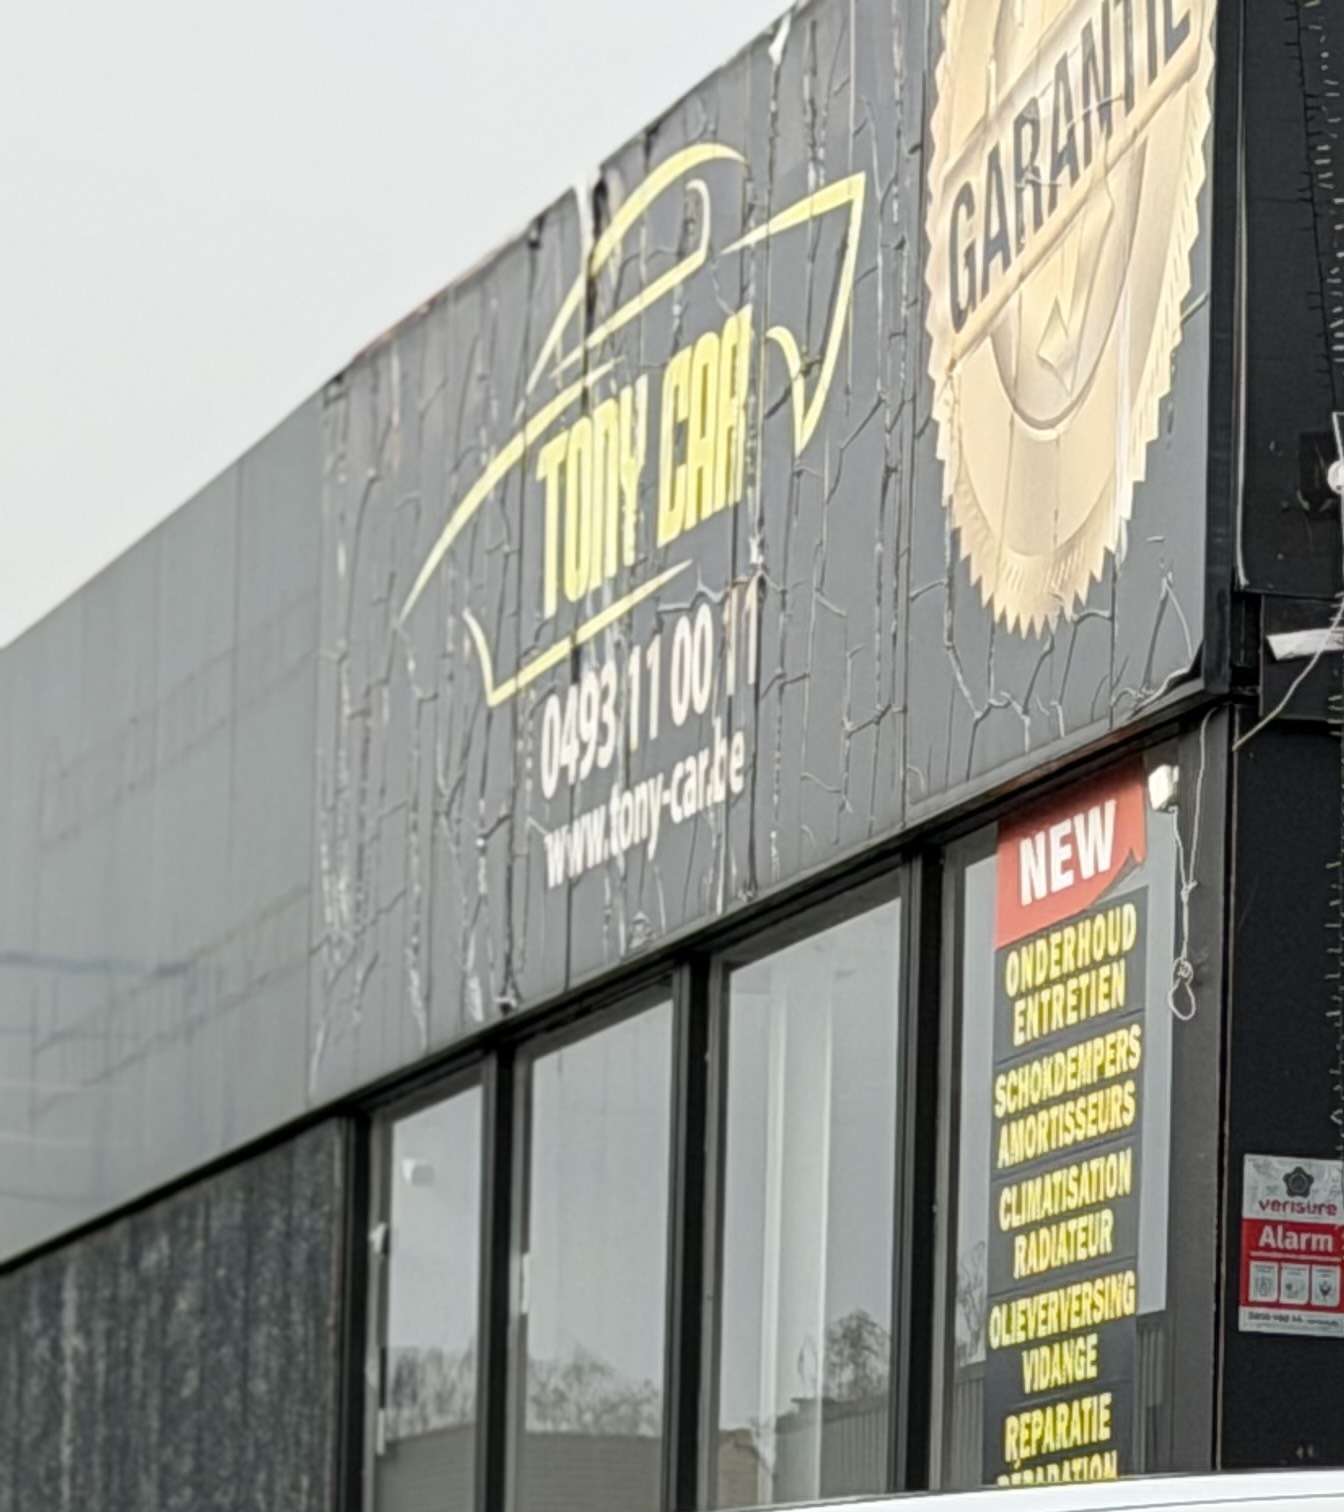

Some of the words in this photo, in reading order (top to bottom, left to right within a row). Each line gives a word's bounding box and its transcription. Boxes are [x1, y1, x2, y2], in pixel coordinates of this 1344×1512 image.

[536, 374, 648, 619] TONY
[656, 304, 754, 549] CAR
[541, 660, 618, 800] 0493
[671, 603, 714, 726] 00
[1020, 799, 1117, 906] NEW
[1005, 903, 1137, 998] ONDERHOUD
[1012, 958, 1126, 1047] ENTRETIEN
[994, 1024, 1142, 1118] SCHOKDEMPERS
[997, 1079, 1137, 1169] AMORTISSEURS
[999, 1147, 1133, 1232] CLIMATISATION
[1259, 1200, 1338, 1217] verisure
[1013, 1208, 1114, 1280] RADIATEUR
[1258, 1224, 1334, 1253] Alarm
[989, 1270, 1137, 1350] OLIEVERVERSING
[1022, 1333, 1099, 1394] VIDANGE
[1004, 1391, 1112, 1463] REPARATIE
